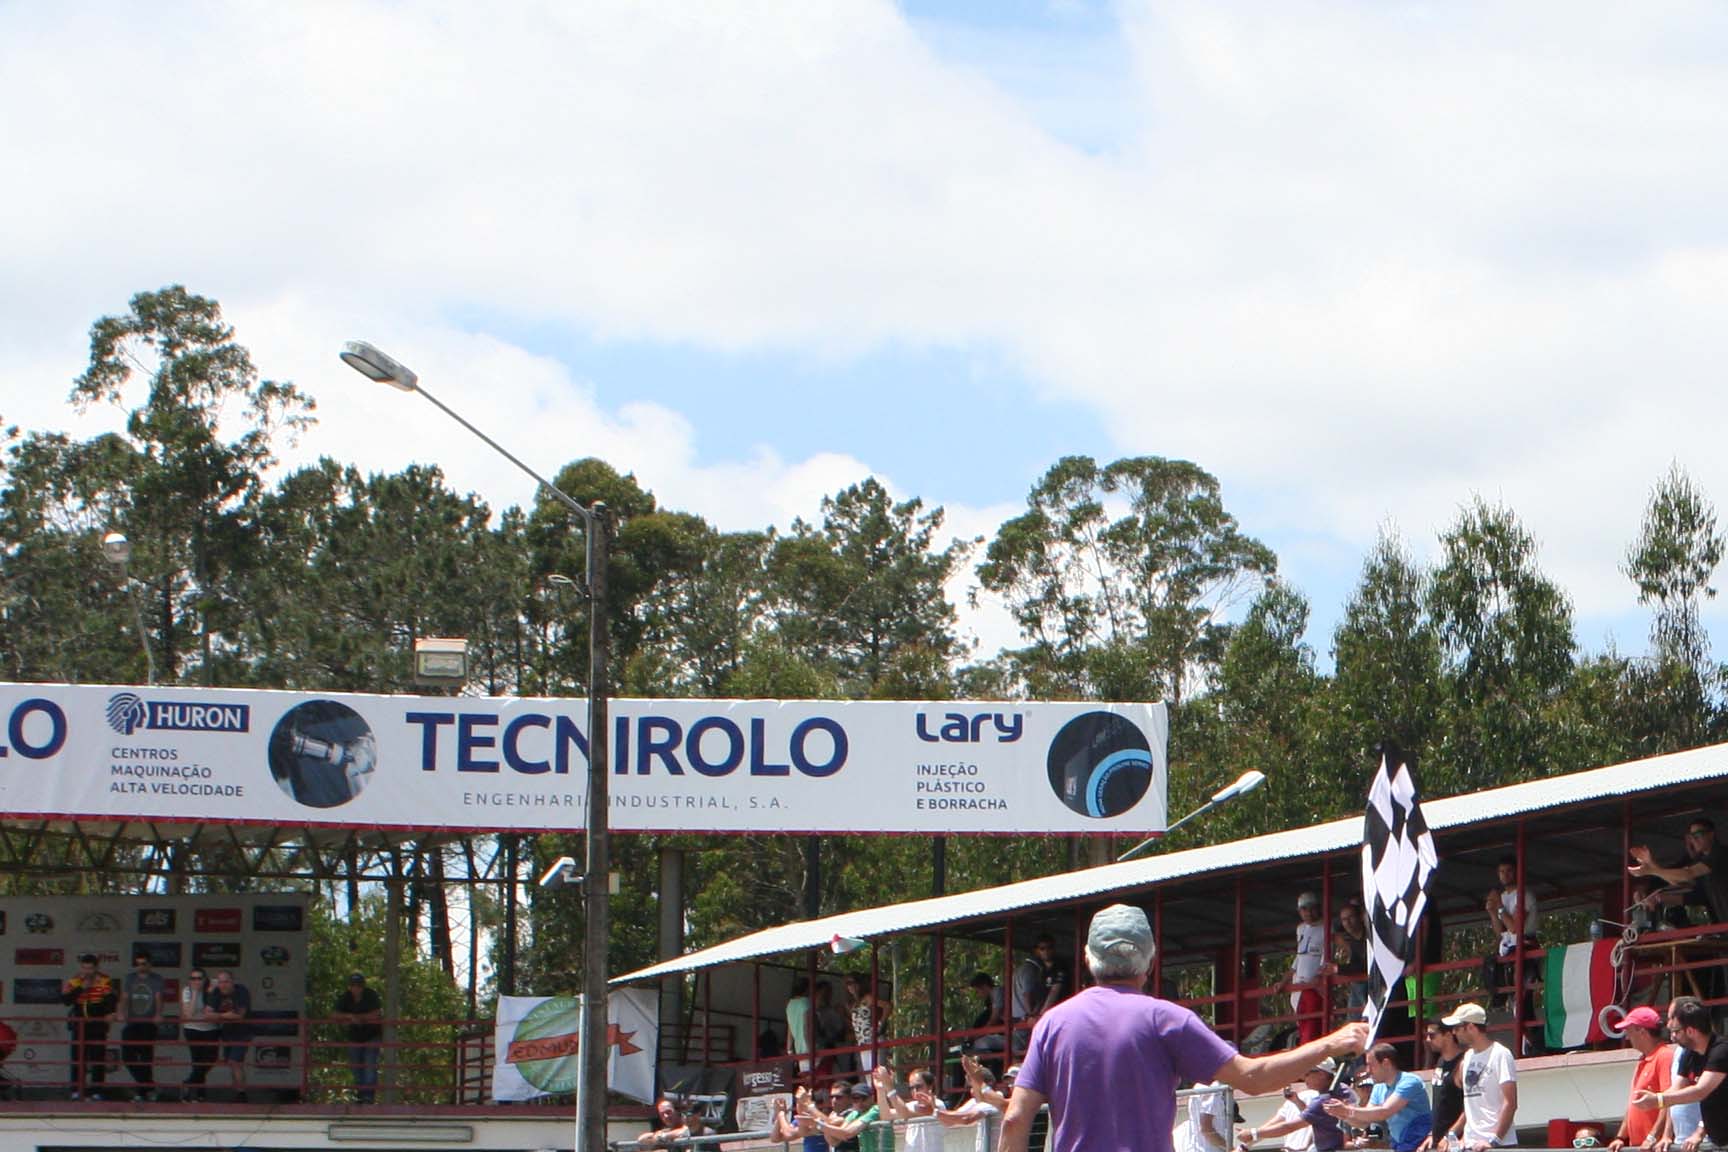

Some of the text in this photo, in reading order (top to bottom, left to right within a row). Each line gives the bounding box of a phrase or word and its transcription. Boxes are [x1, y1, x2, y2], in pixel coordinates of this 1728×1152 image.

[156, 705, 242, 730] HURON
[0, 698, 68, 760] O
[111, 747, 179, 761] CENTROS
[111, 764, 212, 781] MAQUINAÇÃO
[916, 762, 978, 778] INJEÇÃO
[110, 781, 244, 797] ALTA VELOCIDADE
[916, 778, 986, 793] PLÁSTICO
[463, 792, 590, 808] ENGENHARI
[916, 798, 1008, 810] E BORRACHA
